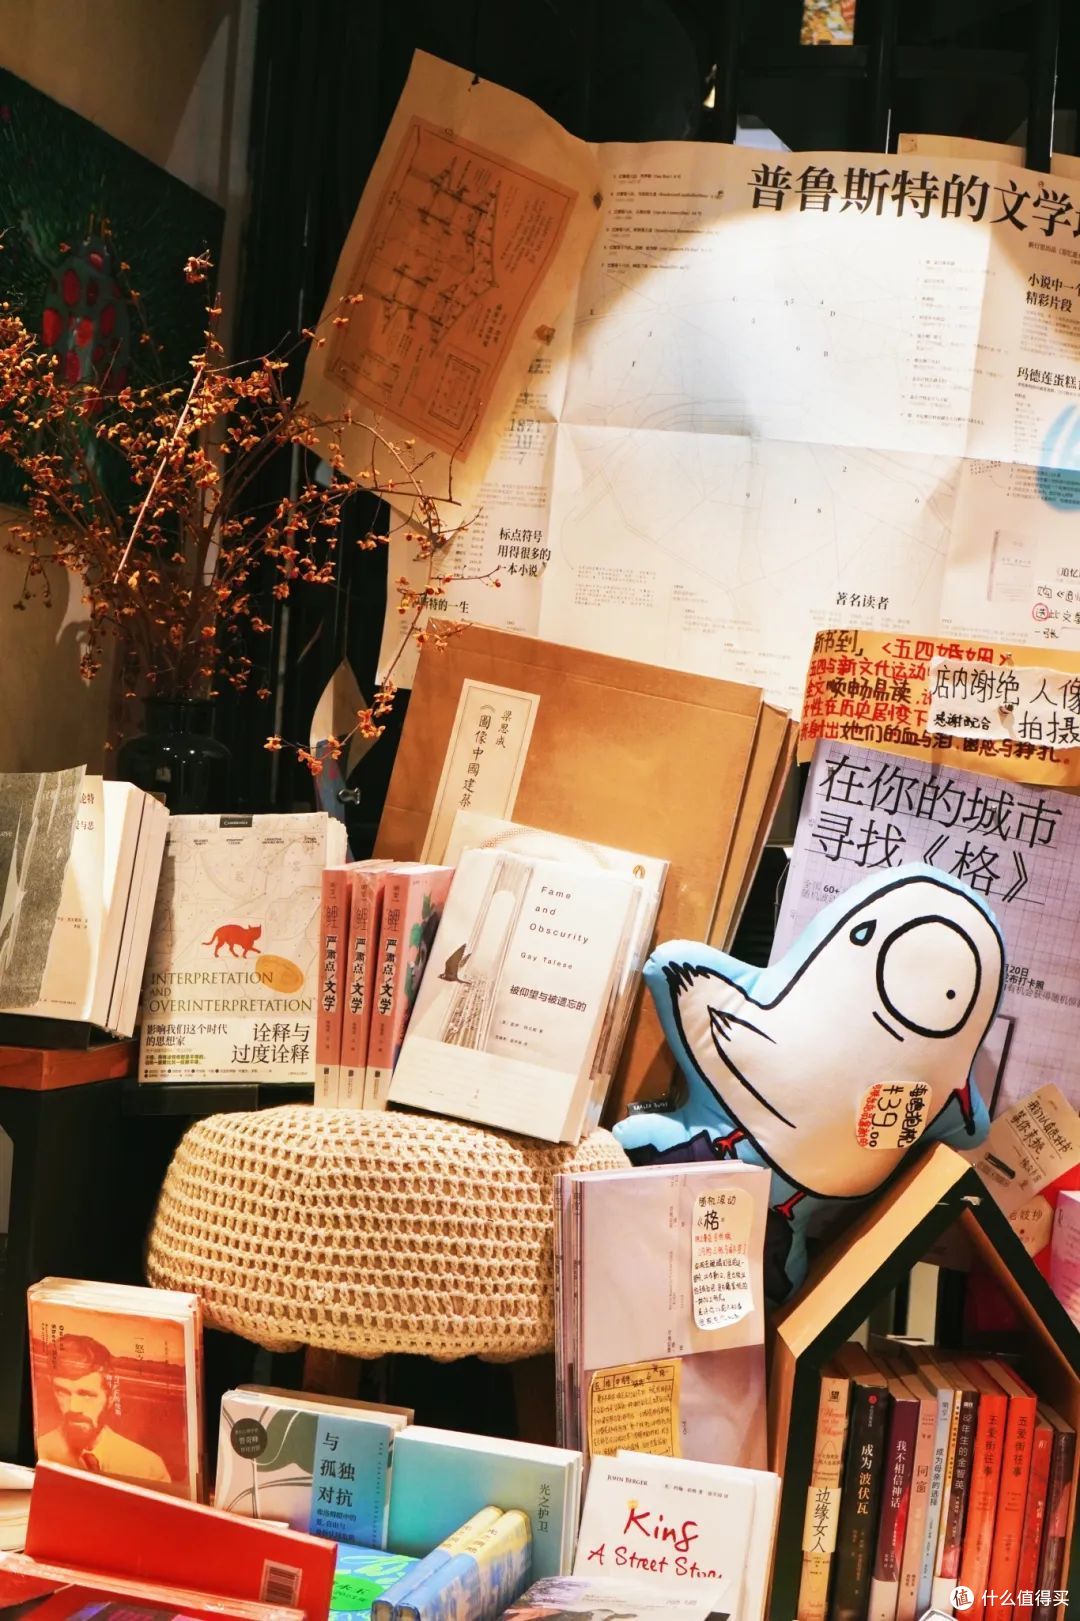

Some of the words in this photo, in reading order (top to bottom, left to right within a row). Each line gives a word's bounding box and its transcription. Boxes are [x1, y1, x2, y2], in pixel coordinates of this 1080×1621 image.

[747, 162, 1080, 238] 普鲁斯特的文学
[1026, 291, 1072, 312] 精彩片段
[1017, 366, 1080, 390] 玛德莲蛋糕
[499, 527, 543, 544] 标点符号
[497, 544, 551, 561] 用得很多的
[498, 562, 538, 577] 一本小说
[836, 591, 889, 610] 著名读者
[932, 665, 1020, 706] 店内谢绝
[1030, 677, 1080, 715] 人像
[934, 711, 991, 731] 感谢配合
[1018, 710, 1080, 744] 拍摄
[817, 755, 1063, 849] 在你的城市
[811, 810, 1028, 903] 寻找《格》
[541, 886, 572, 900] Fame
[535, 905, 556, 916] and
[529, 923, 590, 944] Obscurity
[520, 952, 538, 963] Gay
[542, 957, 573, 970] Talese
[151, 971, 274, 985] INTERPRETATION
[149, 988, 171, 997] AND
[510, 985, 587, 1012] 被仰望与被遗忘的
[149, 999, 313, 1013] OVERINTERPRETATION
[146, 1023, 228, 1035] 影响我们这个时代
[253, 1022, 310, 1043] 诠释与
[145, 1035, 186, 1047] 的思想家
[231, 1044, 310, 1064] 过度诠释
[323, 1432, 339, 1451] 与
[320, 1459, 355, 1482] 孤独
[857, 1444, 874, 1514] 成为波伏瓦
[891, 1440, 907, 1508] 我不相信神话
[318, 1486, 353, 1507] 对抗
[536, 1483, 550, 1533] 光之护卫
[624, 1507, 698, 1552] King
[810, 1486, 831, 1553] 边缘女人
[588, 1544, 605, 1565] A
[615, 1546, 668, 1573] Street
